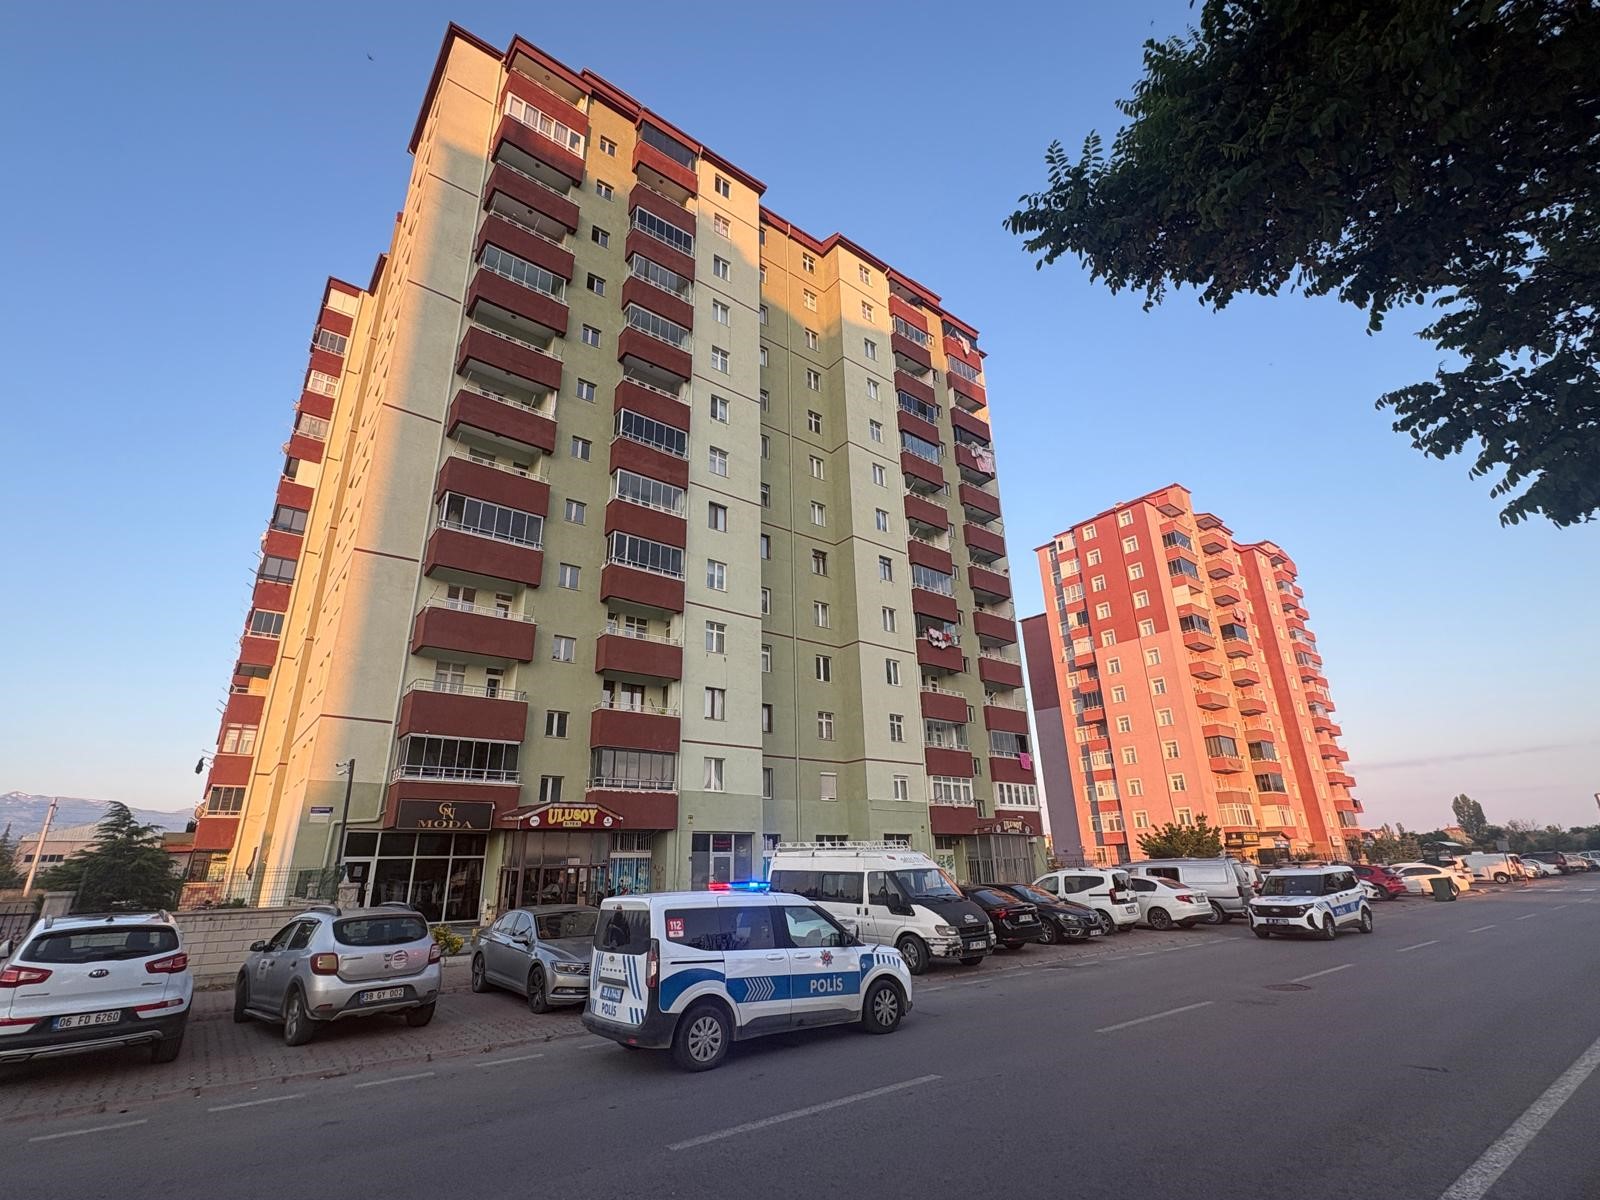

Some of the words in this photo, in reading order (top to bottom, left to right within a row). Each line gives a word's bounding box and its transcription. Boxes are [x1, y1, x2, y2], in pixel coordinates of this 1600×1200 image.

[418, 819, 473, 829] MODA
[547, 808, 598, 825] ULUSOY
[669, 920, 682, 930] 112
[810, 974, 844, 994] POLİS
[60, 1018, 71, 1028] 06
[94, 1011, 119, 1023] 6260
